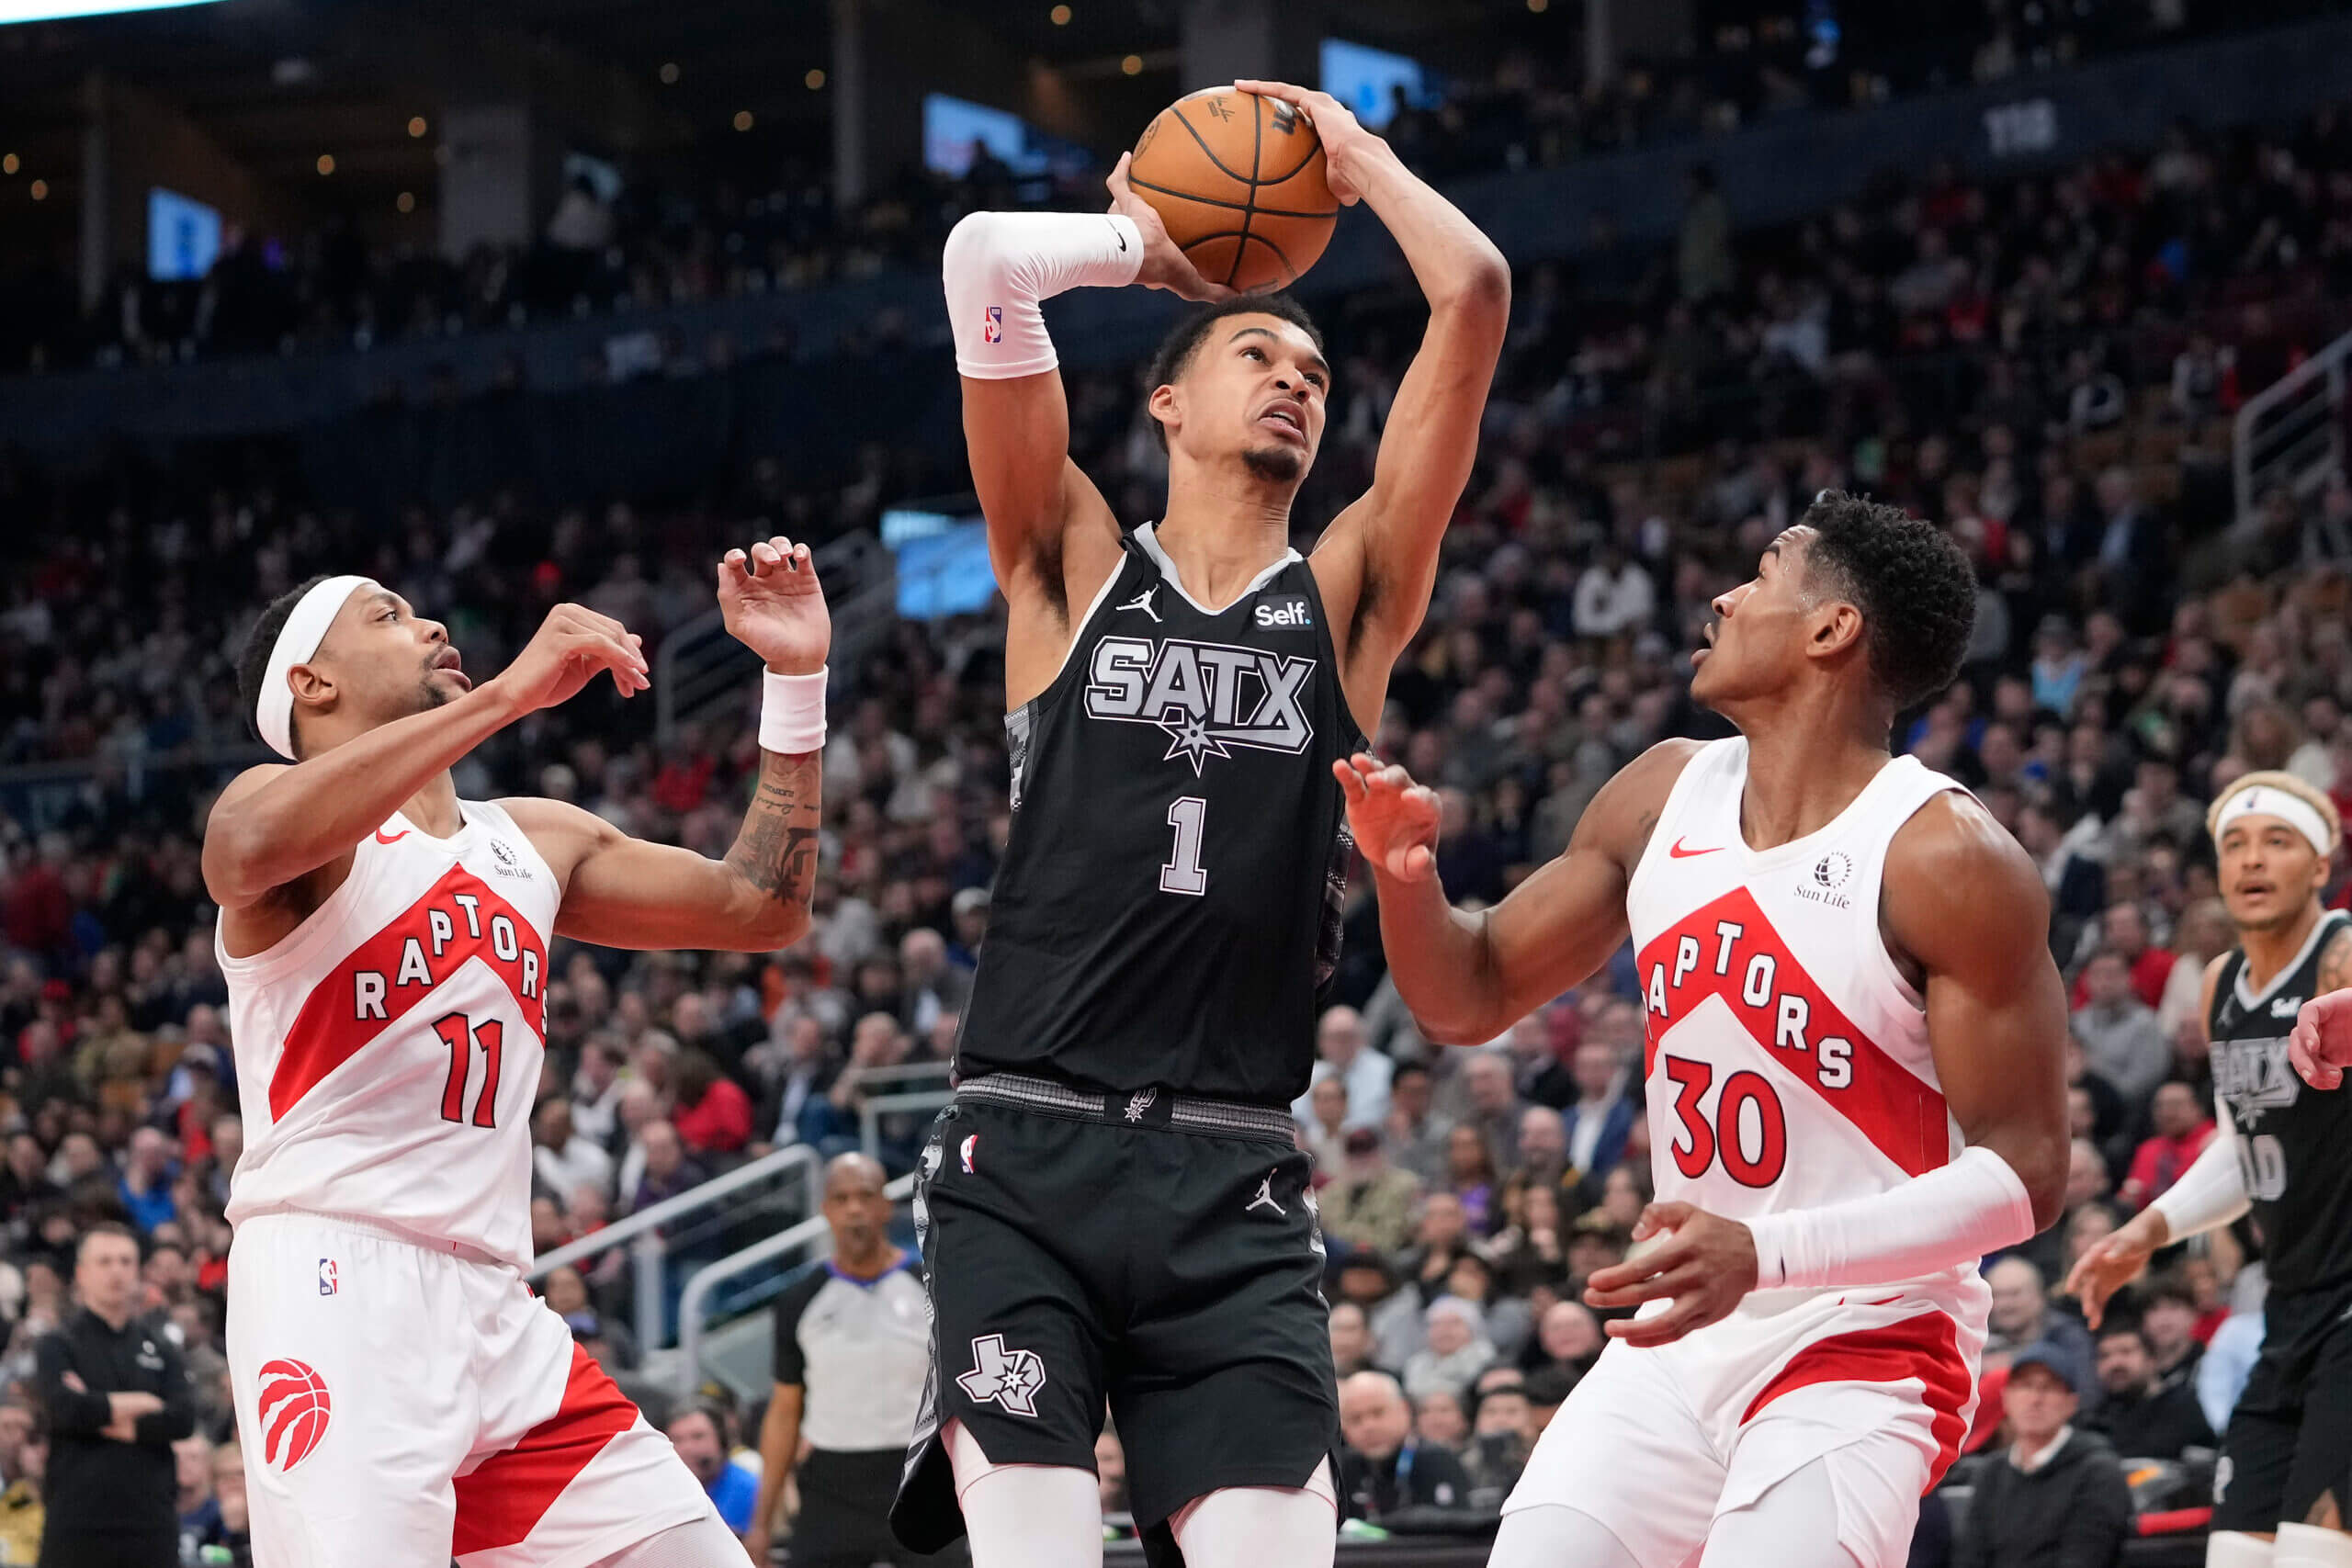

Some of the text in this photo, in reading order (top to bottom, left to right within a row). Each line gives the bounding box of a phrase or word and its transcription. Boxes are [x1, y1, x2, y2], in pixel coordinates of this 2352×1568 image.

[1084, 636, 1317, 757] SATX
[1159, 796, 1207, 897] 1
[1793, 882, 1851, 909] Sun Life
[1642, 919, 1853, 1089] APTORS
[431, 1011, 503, 1129] 11
[1665, 1054, 1787, 1189] 30
